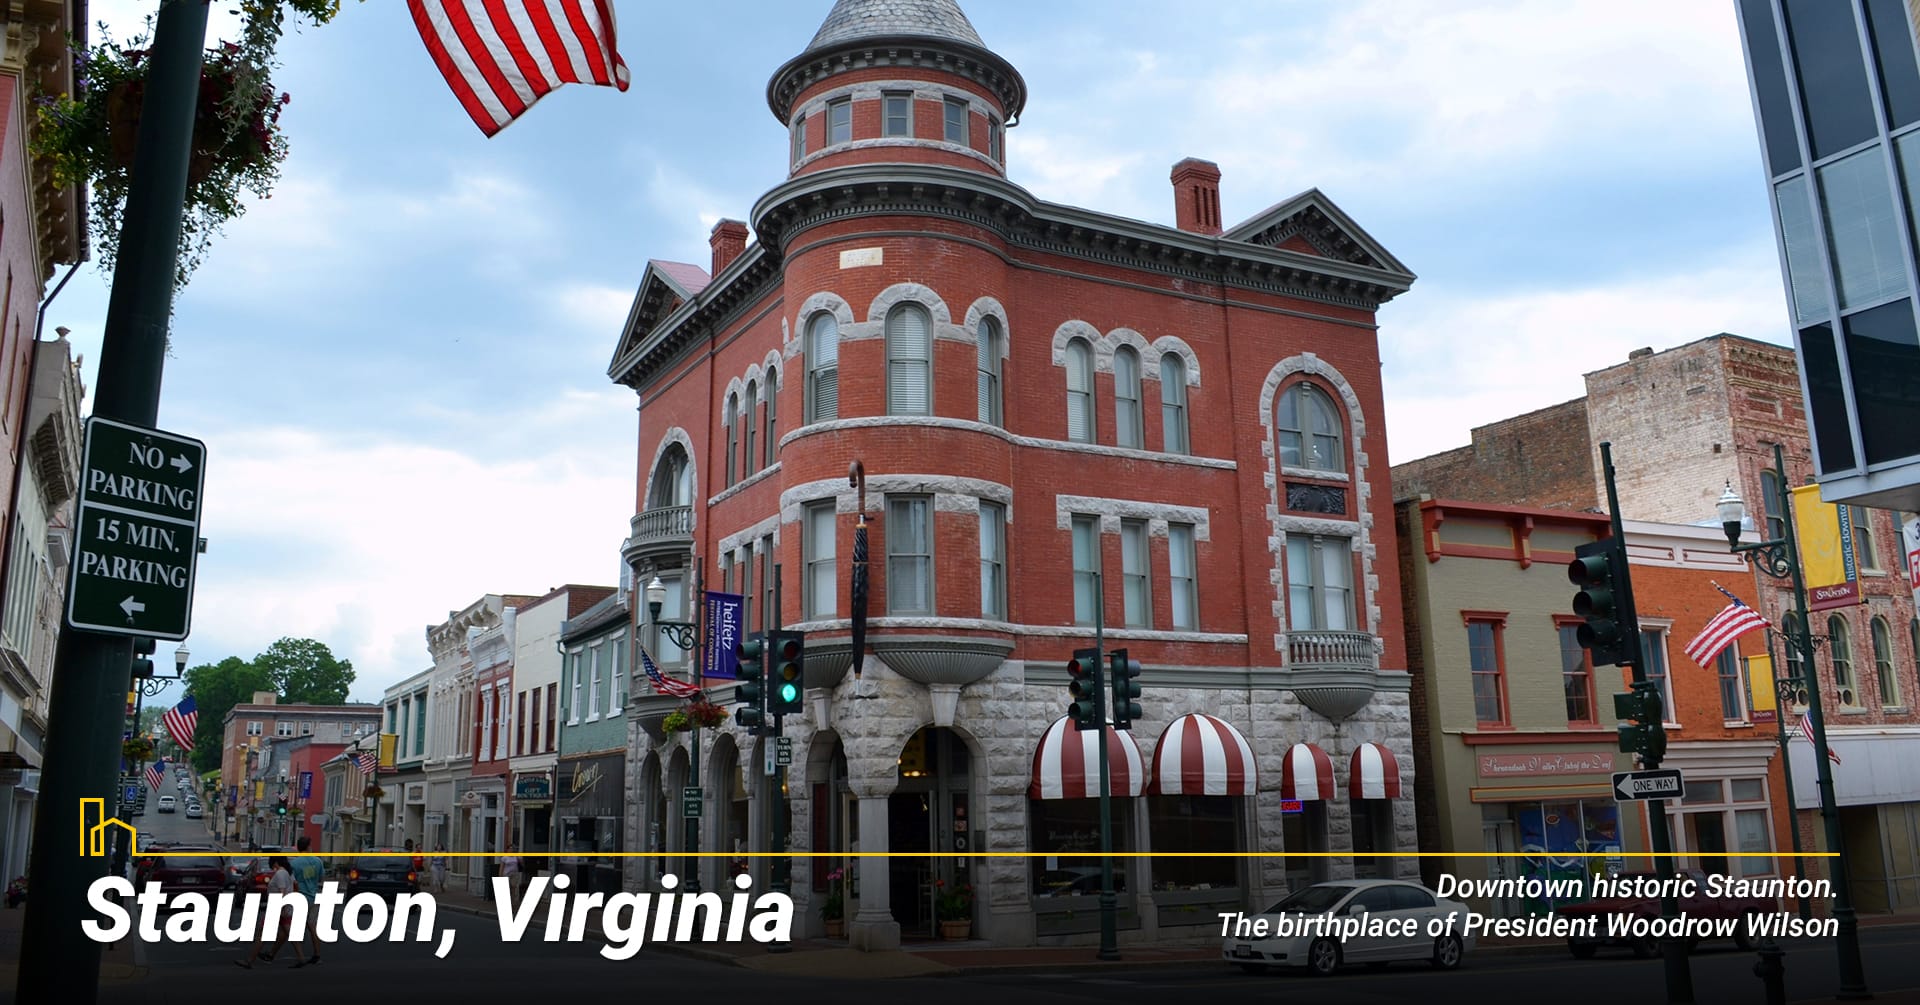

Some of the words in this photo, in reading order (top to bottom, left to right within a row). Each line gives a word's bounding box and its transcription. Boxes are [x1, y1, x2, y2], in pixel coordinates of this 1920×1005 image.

[128, 441, 164, 470] NO
[89, 469, 195, 510] PARKING
[96, 517, 121, 541] 15
[125, 522, 180, 553] MIN.
[80, 550, 187, 589] PARKING
[1843, 543, 1856, 581] historic
[709, 628, 715, 637] OF
[722, 602, 738, 650] heifetz
[1633, 780, 1653, 791] ONE
[1655, 778, 1675, 790] WAY
